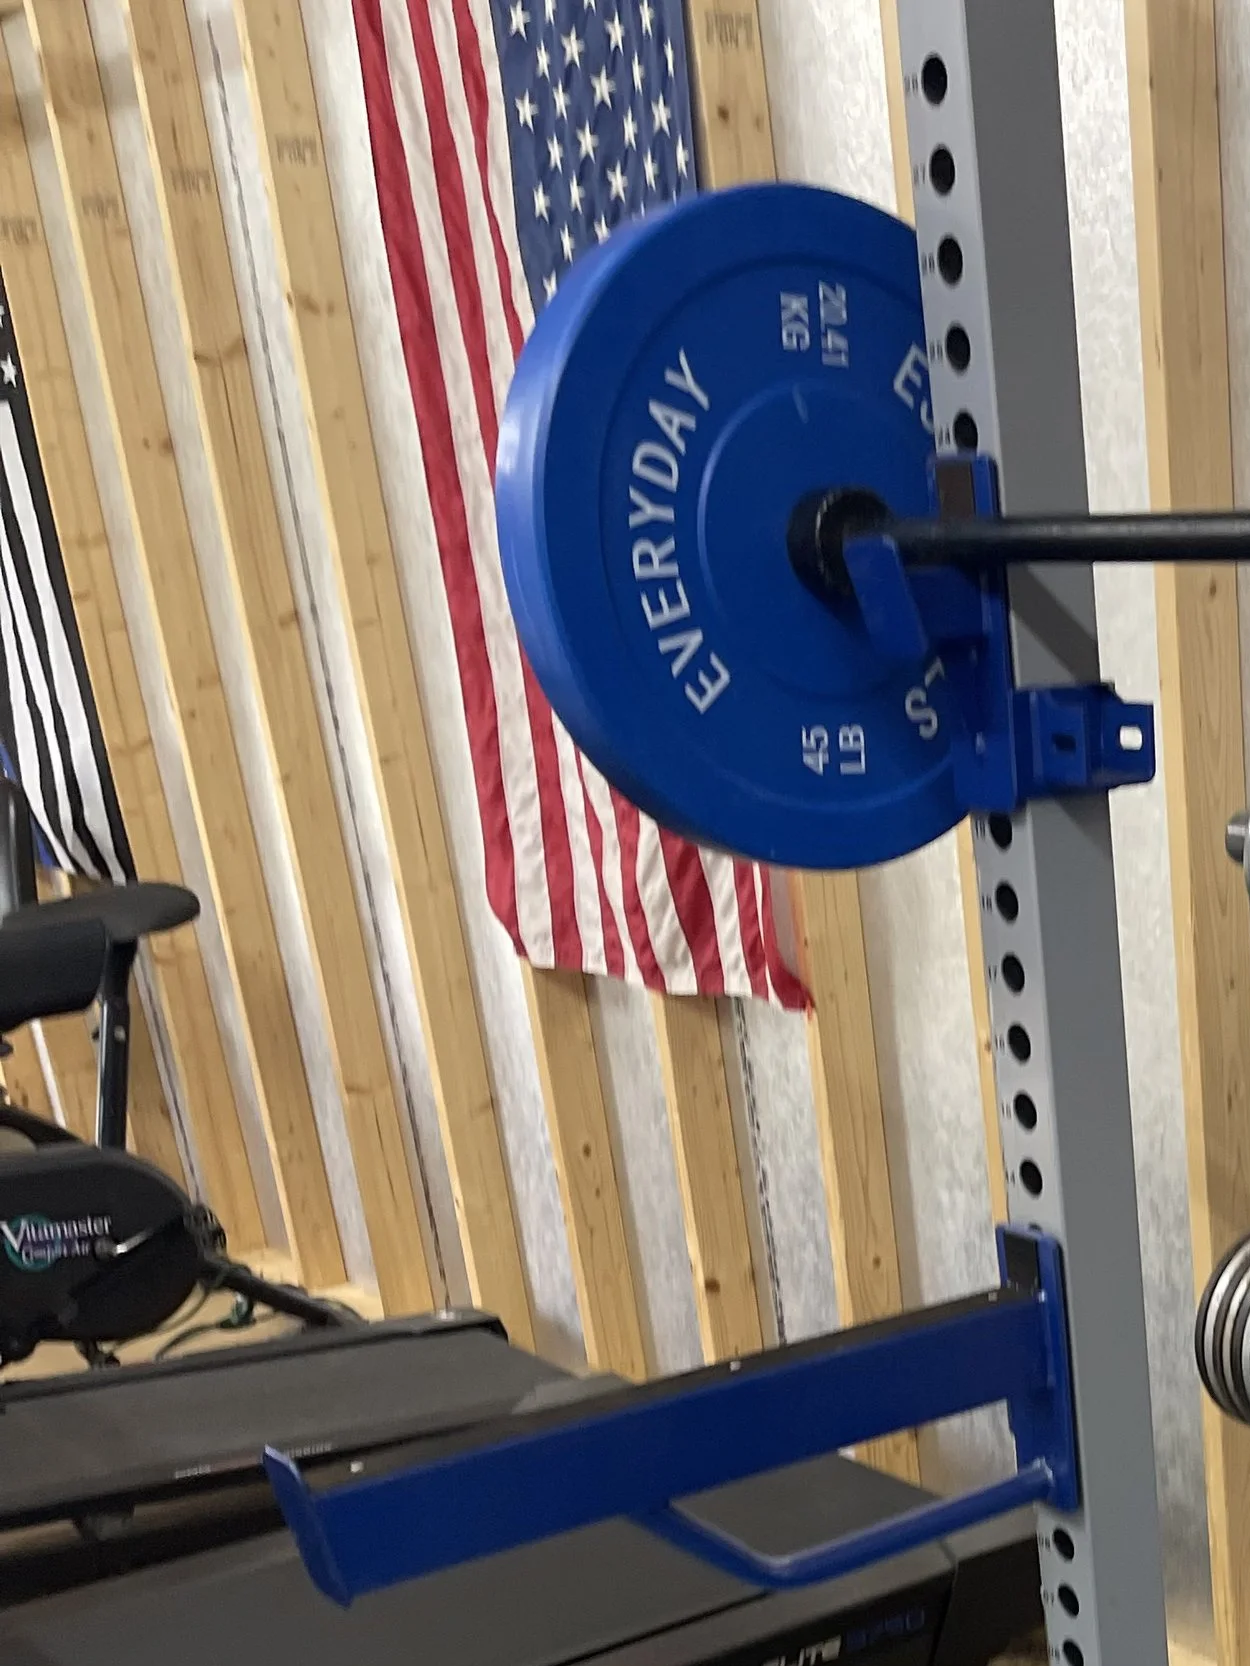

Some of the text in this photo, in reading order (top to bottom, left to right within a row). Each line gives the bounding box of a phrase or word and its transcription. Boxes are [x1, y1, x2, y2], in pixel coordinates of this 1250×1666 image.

[779, 291, 811, 351] KG
[628, 346, 732, 714] EVERYDAY
[801, 725, 829, 776] 45
[838, 723, 866, 775] LB
